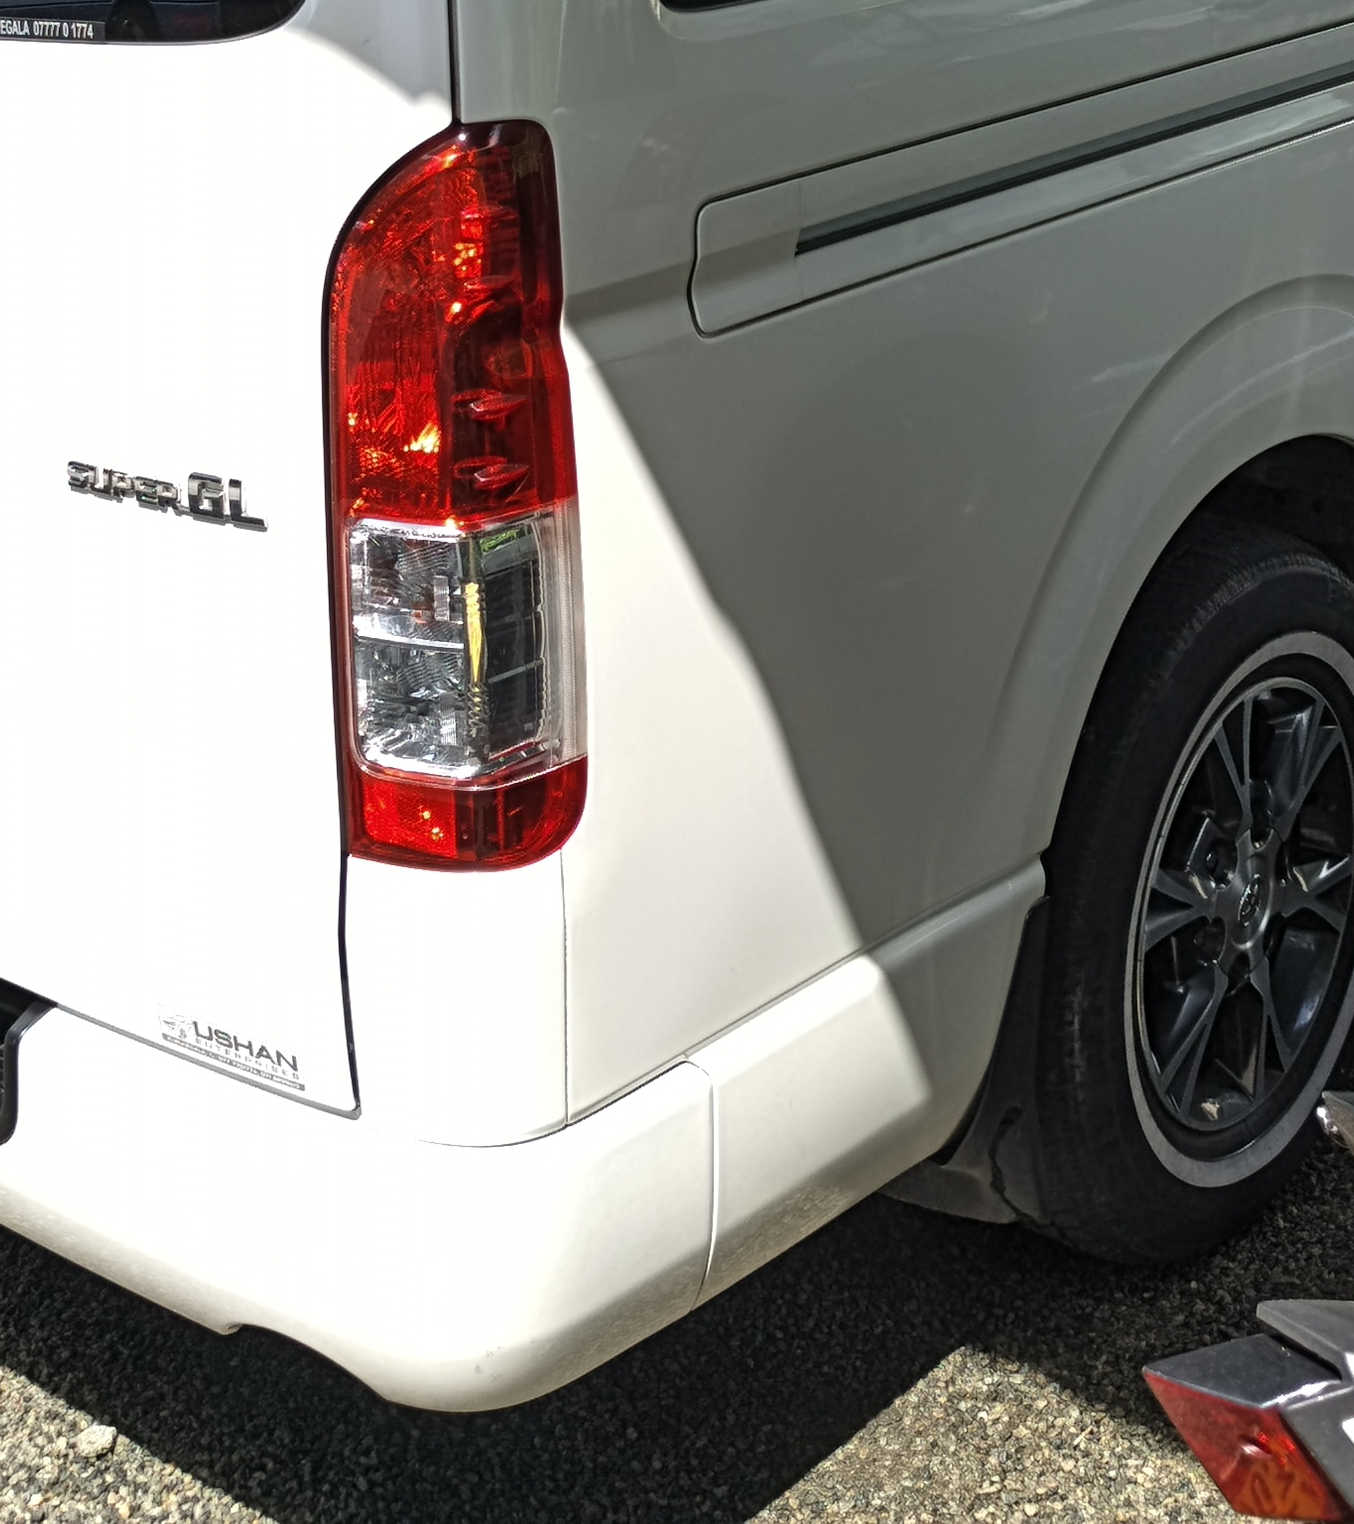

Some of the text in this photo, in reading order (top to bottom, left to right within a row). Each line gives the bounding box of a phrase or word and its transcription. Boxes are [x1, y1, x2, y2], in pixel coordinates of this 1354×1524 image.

[33, 21, 60, 37] 07777
[71, 23, 94, 39] 1774
[188, 472, 268, 533] GL
[192, 1020, 298, 1072] USHAN
